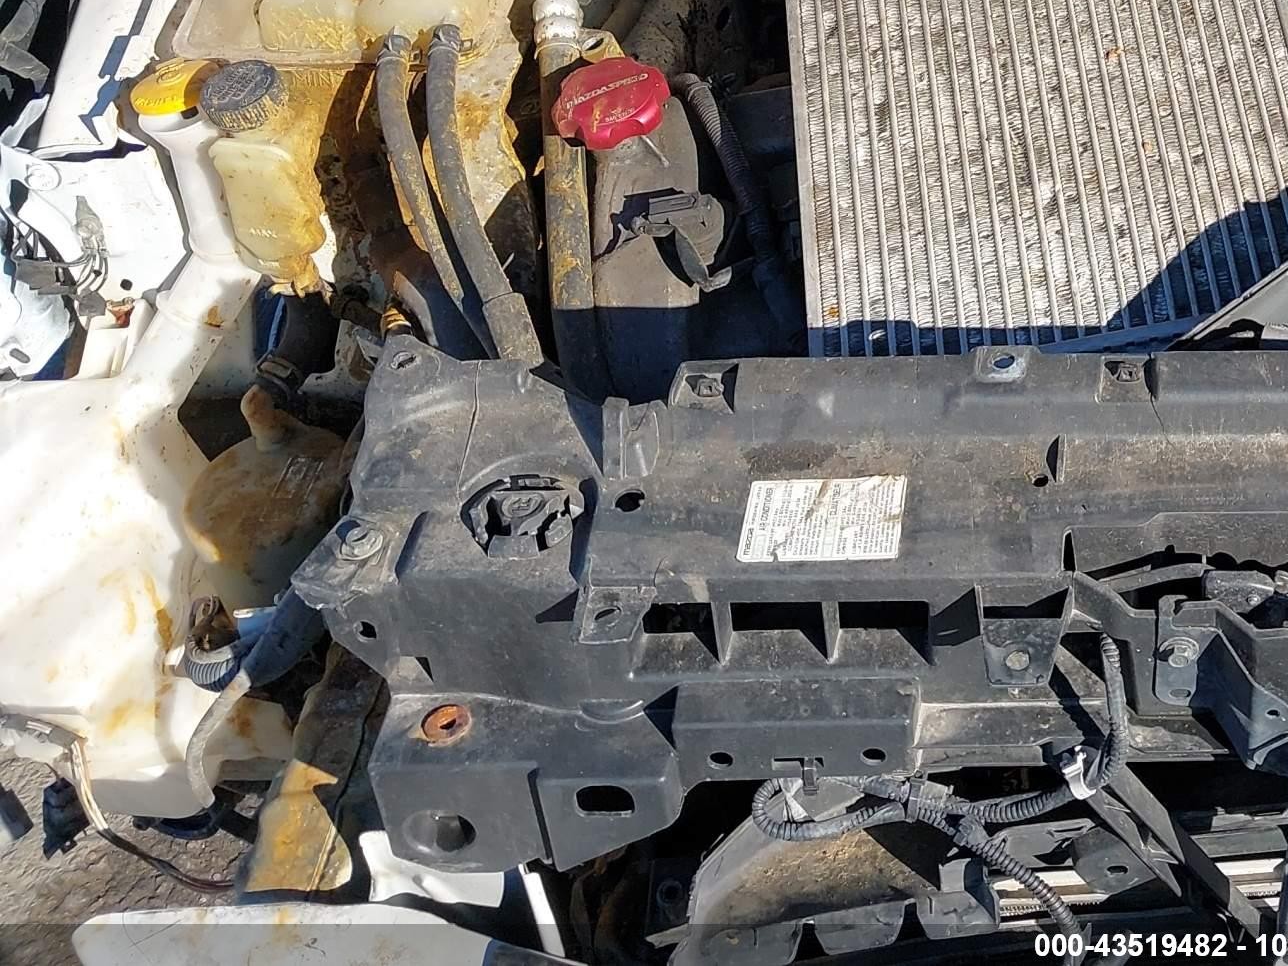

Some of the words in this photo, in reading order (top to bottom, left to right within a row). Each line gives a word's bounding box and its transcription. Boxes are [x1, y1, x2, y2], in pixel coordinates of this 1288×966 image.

[566, 72, 649, 110] MAZDASPEED
[761, 487, 774, 522] CONDITIONER
[743, 527, 754, 556] mazda
